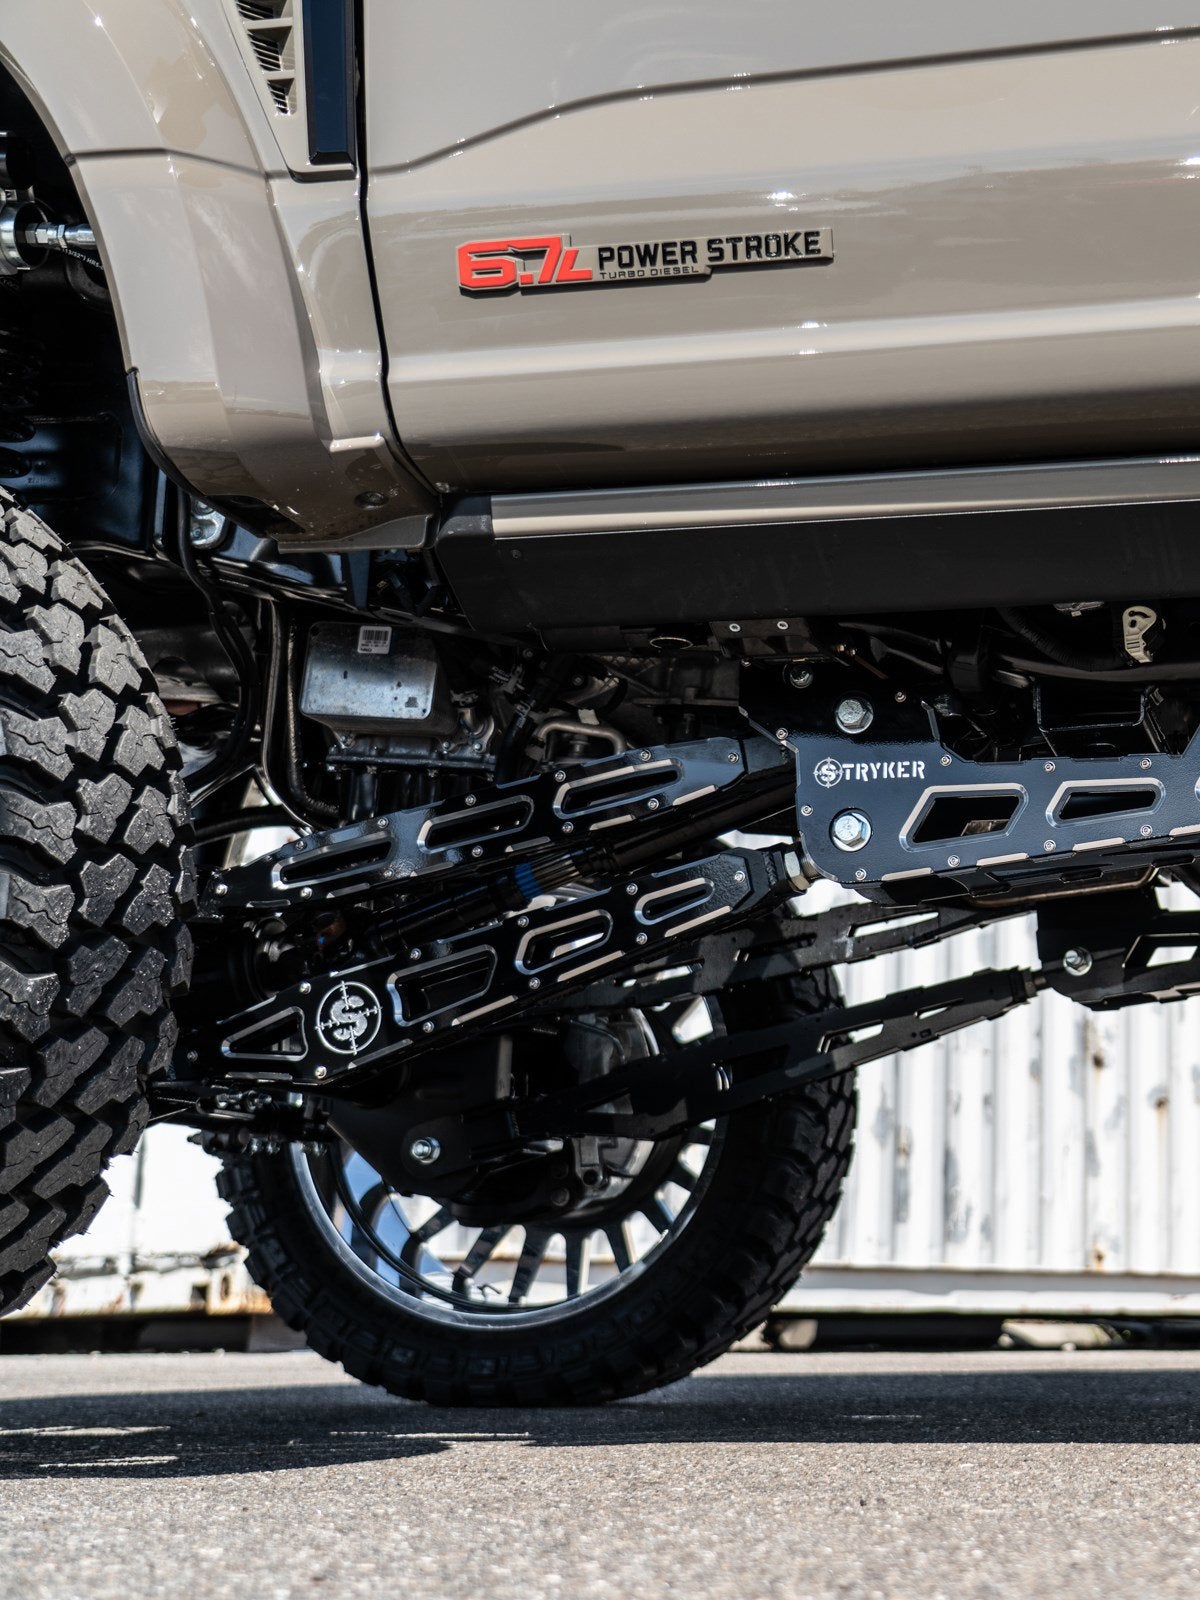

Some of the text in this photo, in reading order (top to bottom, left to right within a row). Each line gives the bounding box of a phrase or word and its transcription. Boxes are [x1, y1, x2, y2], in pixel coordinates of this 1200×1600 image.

[458, 231, 822, 289] 6.7L POWER STROKE
[600, 265, 700, 281] TURBO DIESEL
[819, 760, 926, 783] STRYKER
